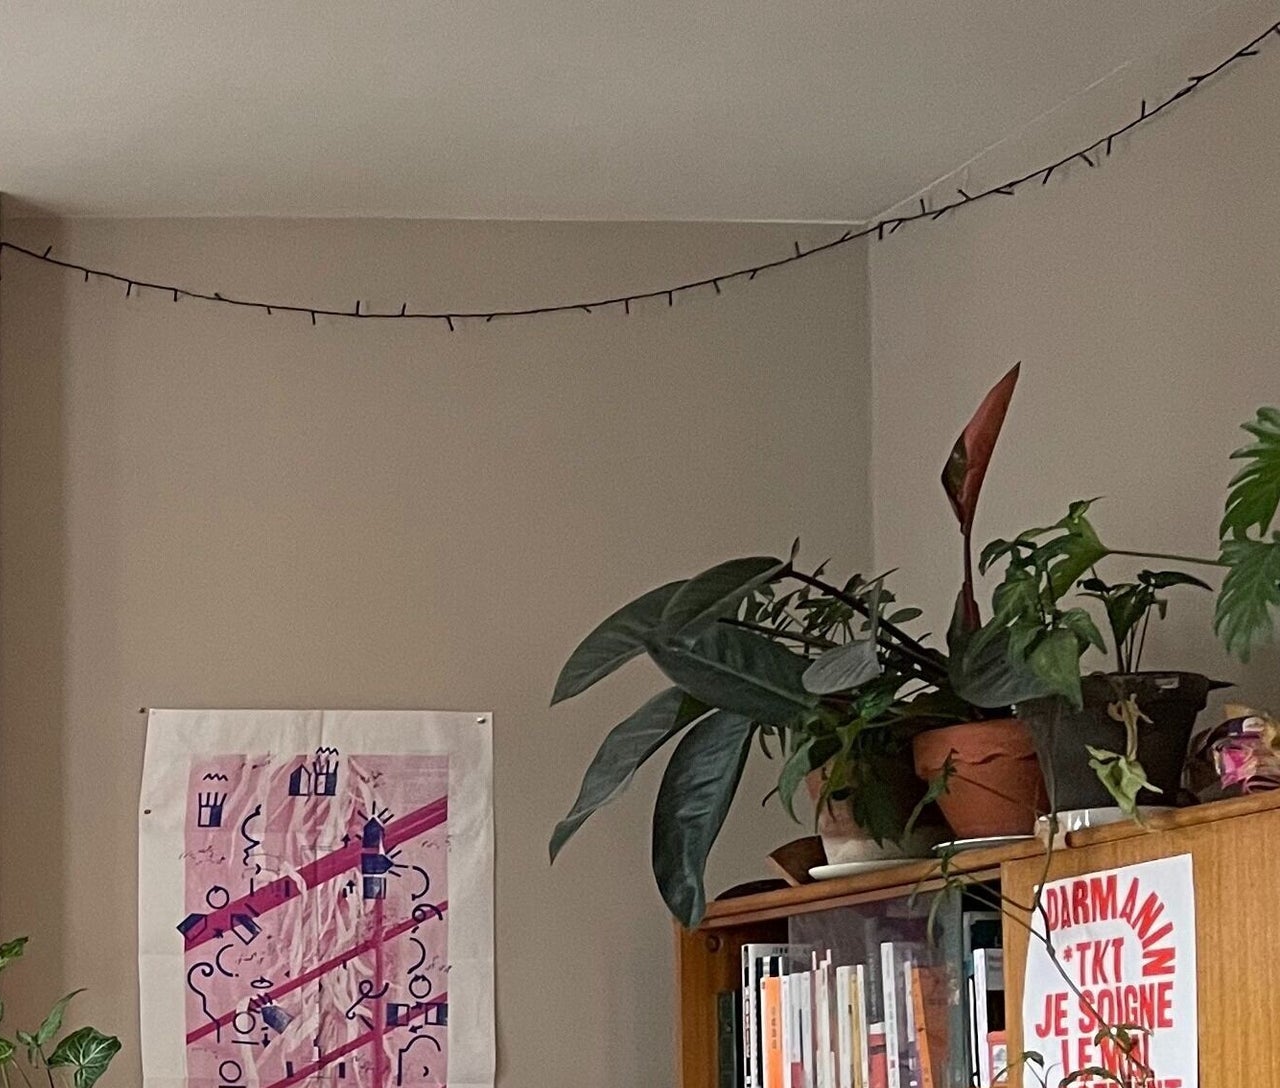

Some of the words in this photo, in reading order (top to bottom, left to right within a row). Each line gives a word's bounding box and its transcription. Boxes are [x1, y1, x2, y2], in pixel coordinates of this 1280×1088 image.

[1046, 874, 1177, 978] DARMANIN
[1035, 991, 1069, 1039] JE
[1078, 980, 1174, 1034] SOIGNE
